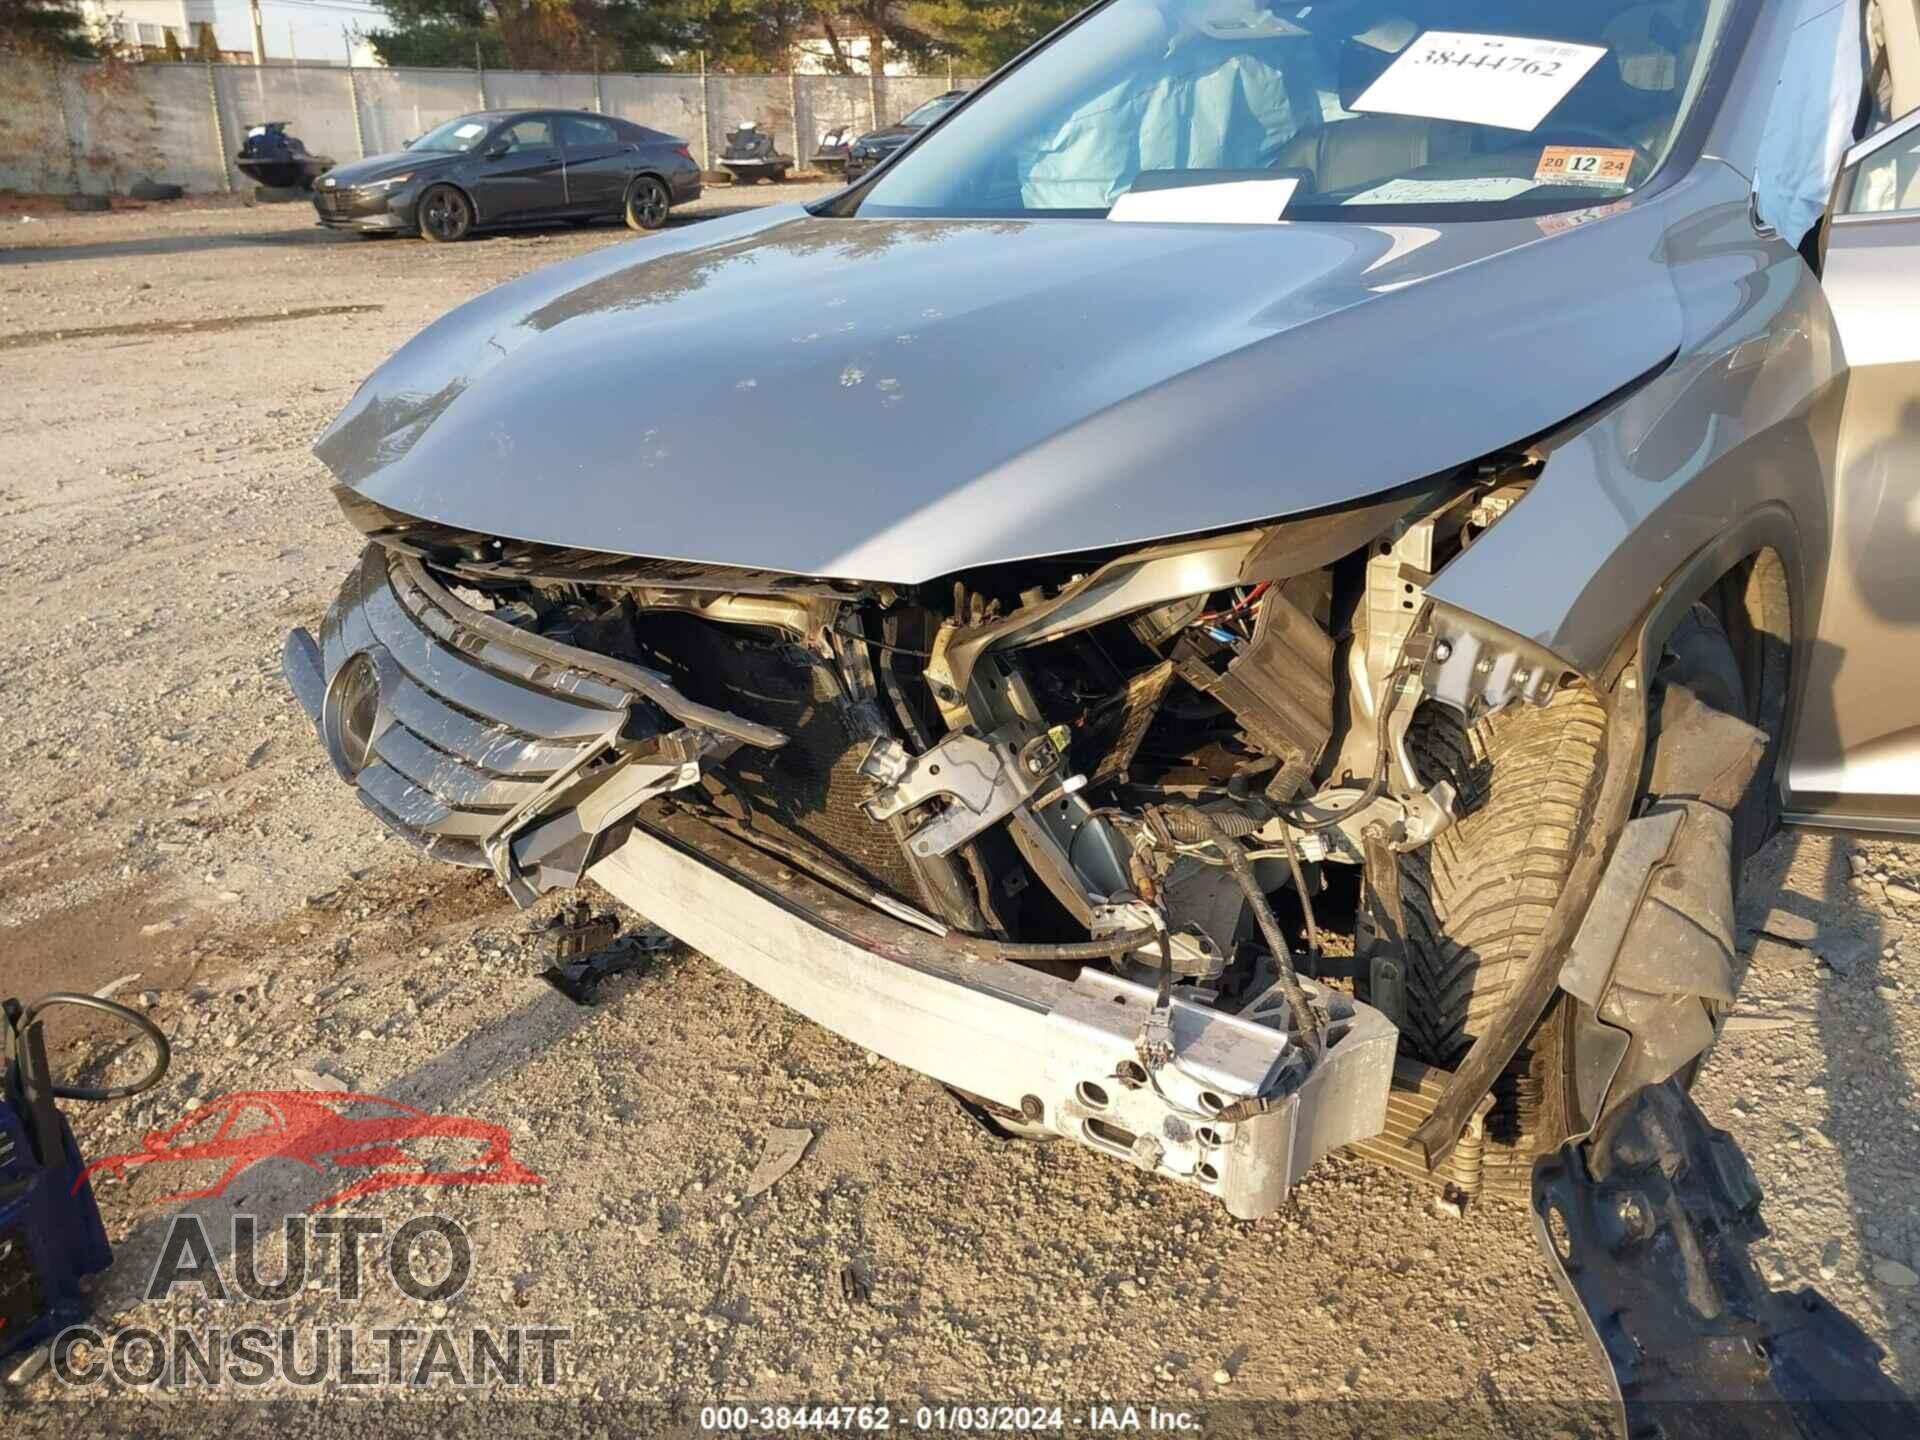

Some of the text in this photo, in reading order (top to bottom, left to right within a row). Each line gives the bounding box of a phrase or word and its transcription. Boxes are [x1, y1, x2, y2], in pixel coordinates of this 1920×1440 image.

[1414, 49, 1562, 77] 38444762
[1543, 156, 1625, 172] 20 12 24
